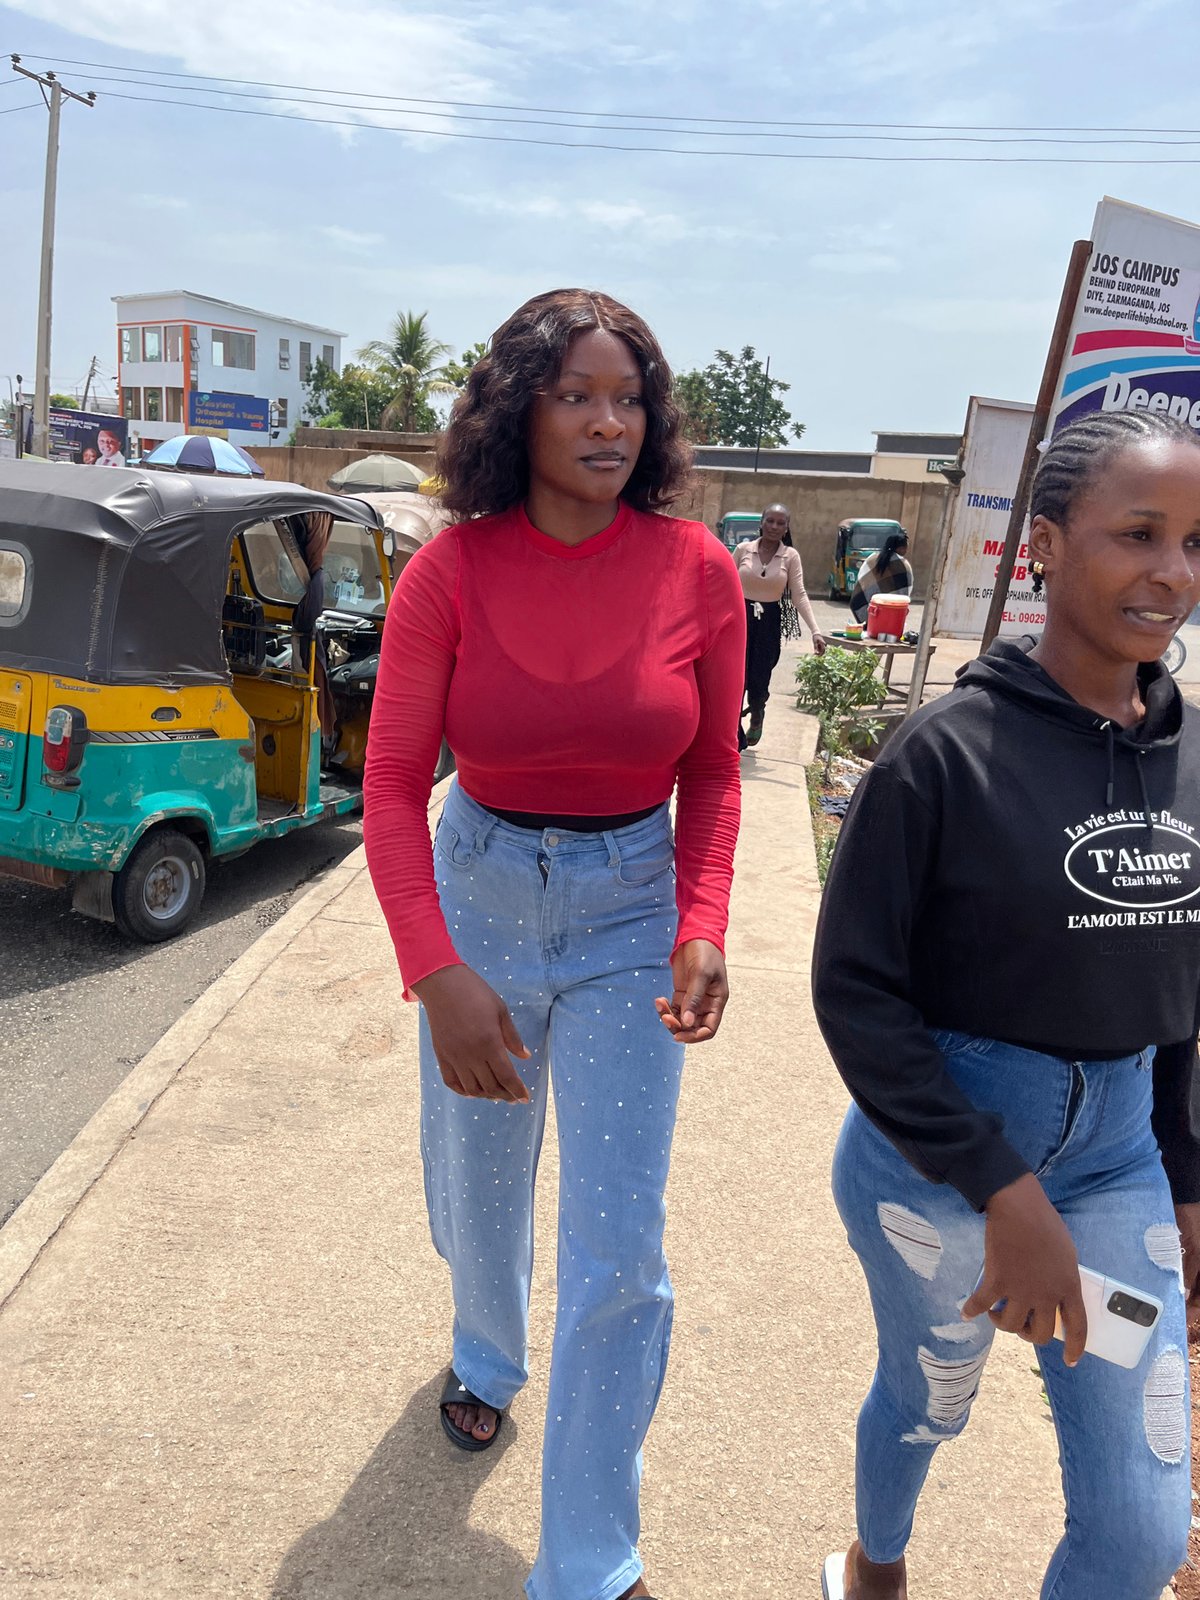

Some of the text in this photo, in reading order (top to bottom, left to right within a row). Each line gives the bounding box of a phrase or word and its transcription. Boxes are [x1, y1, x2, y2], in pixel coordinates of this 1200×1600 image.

[1092, 253, 1180, 287] JOS CAMPUS
[1089, 276, 1161, 298] BEHIND EUROPHARM
[1086, 289, 1171, 313] DIYE, ZARMAGANDA, JOS
[195, 417, 224, 425] Hospital
[983, 540, 1031, 559] MAE
[982, 588, 993, 599] OFF
[1035, 592, 1047, 603] ROA
[1001, 611, 1016, 622] EL:
[1064, 825, 1087, 841] La
[1084, 813, 1106, 830] vie
[1107, 808, 1128, 823] est
[1160, 809, 1195, 835] fleur
[1146, 874, 1162, 886] Ma
[1162, 873, 1182, 885] Vie.
[1067, 912, 1137, 929] L'AMOUR
[1139, 911, 1166, 925] EST
[1167, 910, 1184, 924] LE
